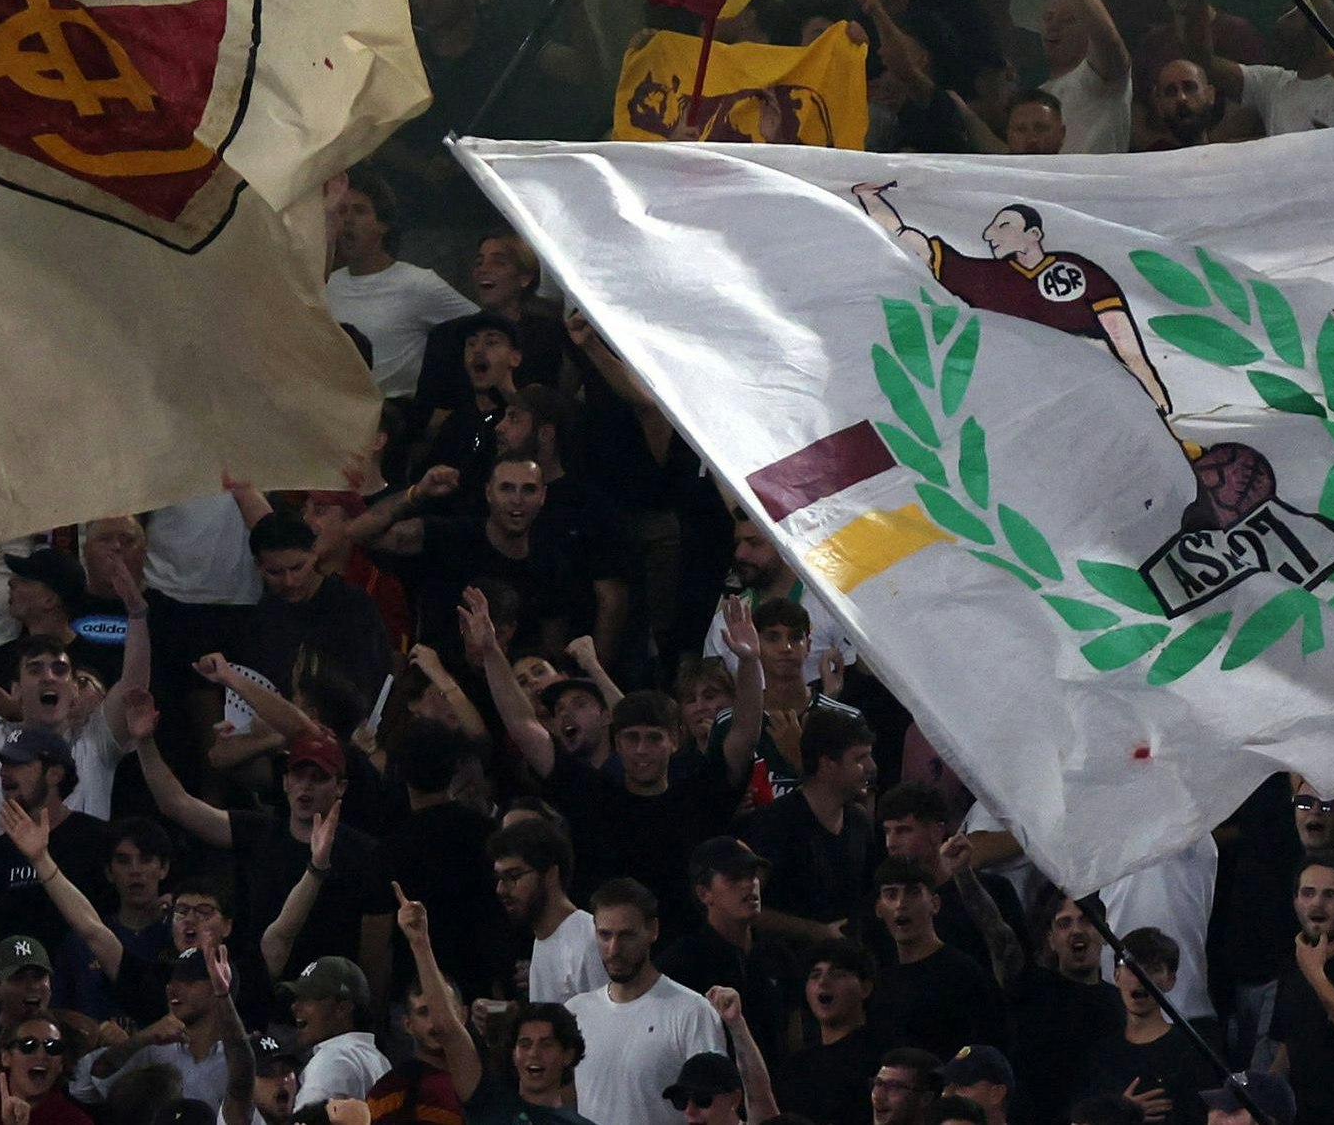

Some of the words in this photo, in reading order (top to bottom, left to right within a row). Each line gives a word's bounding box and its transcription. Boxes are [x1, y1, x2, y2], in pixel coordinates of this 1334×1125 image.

[1043, 264, 1083, 297] ASR
[82, 623, 126, 635] adida
[15, 941, 33, 956] NY
